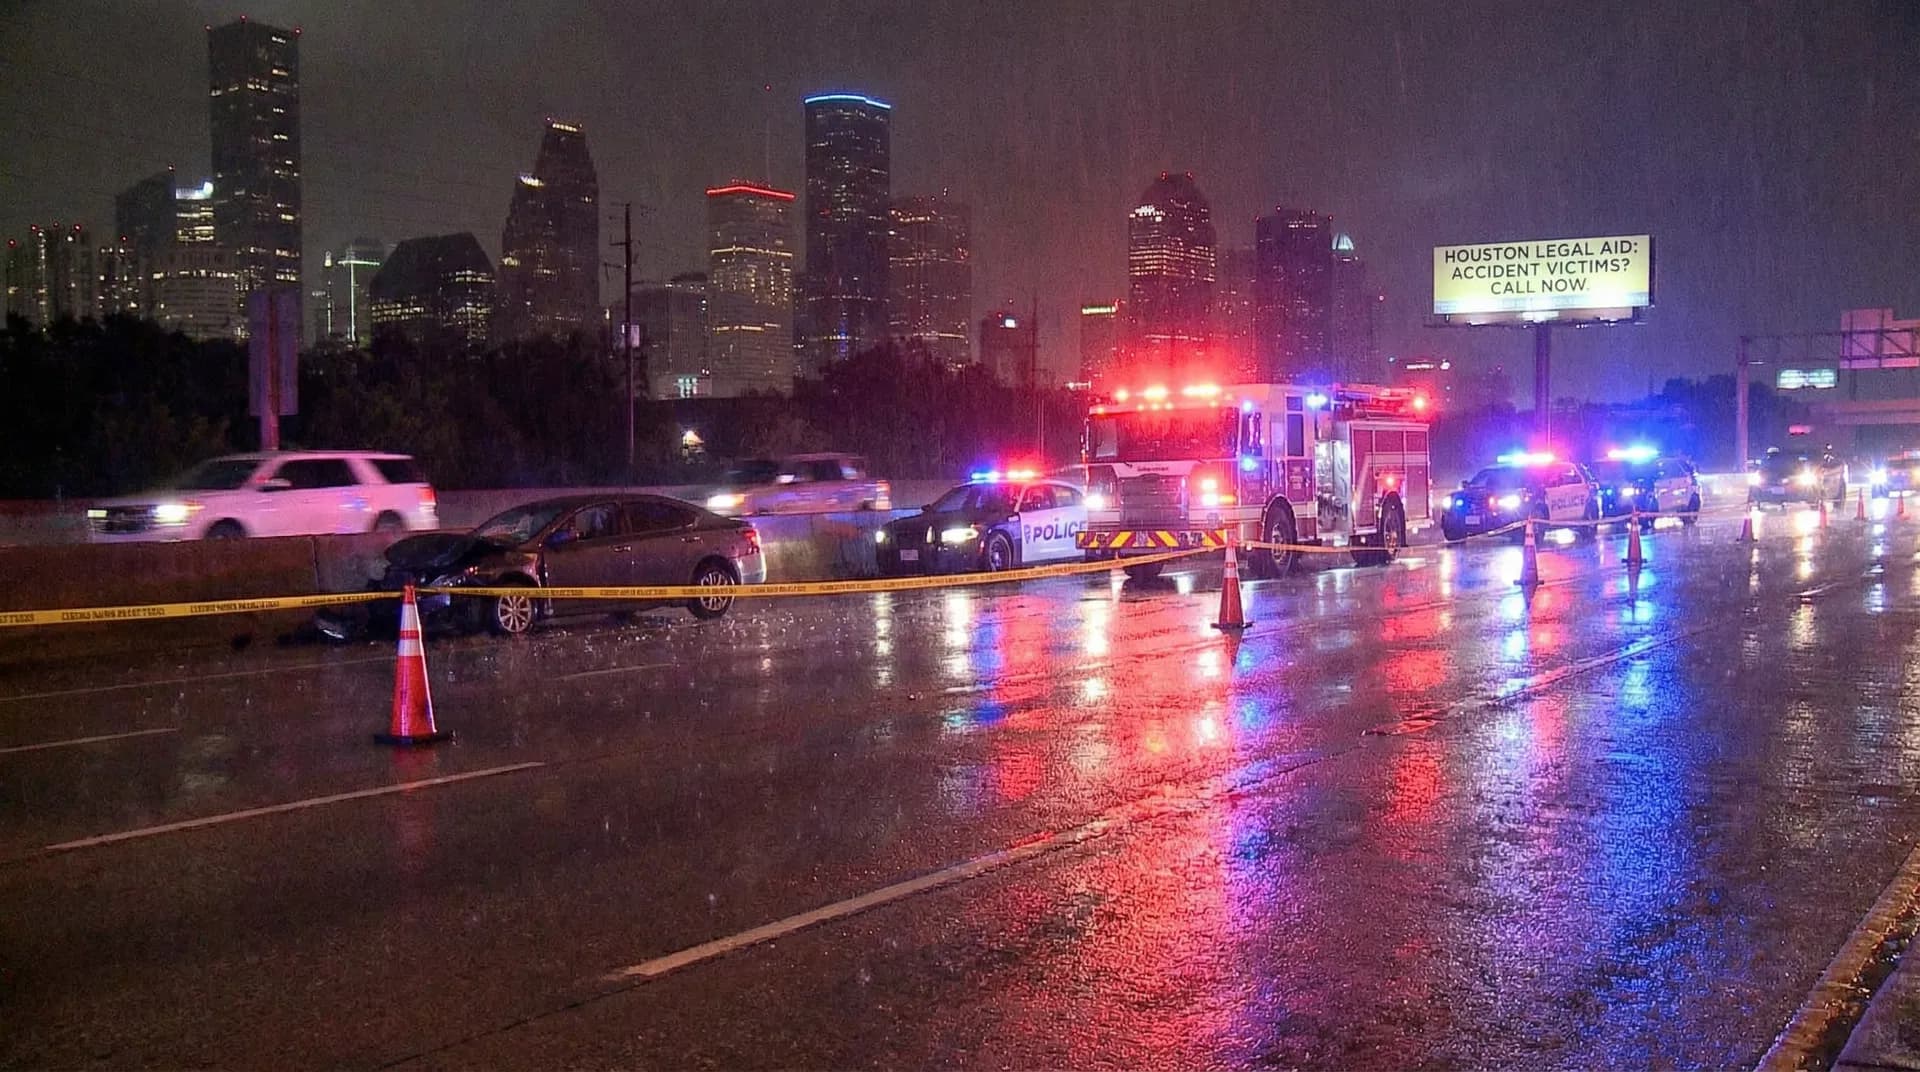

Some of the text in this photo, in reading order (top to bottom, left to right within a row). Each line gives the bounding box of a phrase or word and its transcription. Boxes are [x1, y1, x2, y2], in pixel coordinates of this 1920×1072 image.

[1445, 240, 1639, 264] HOUSTON LEGAL AID:
[1451, 258, 1631, 280] ACCIDENT VICTIMS?
[1490, 278, 1591, 295] CALL NOW.
